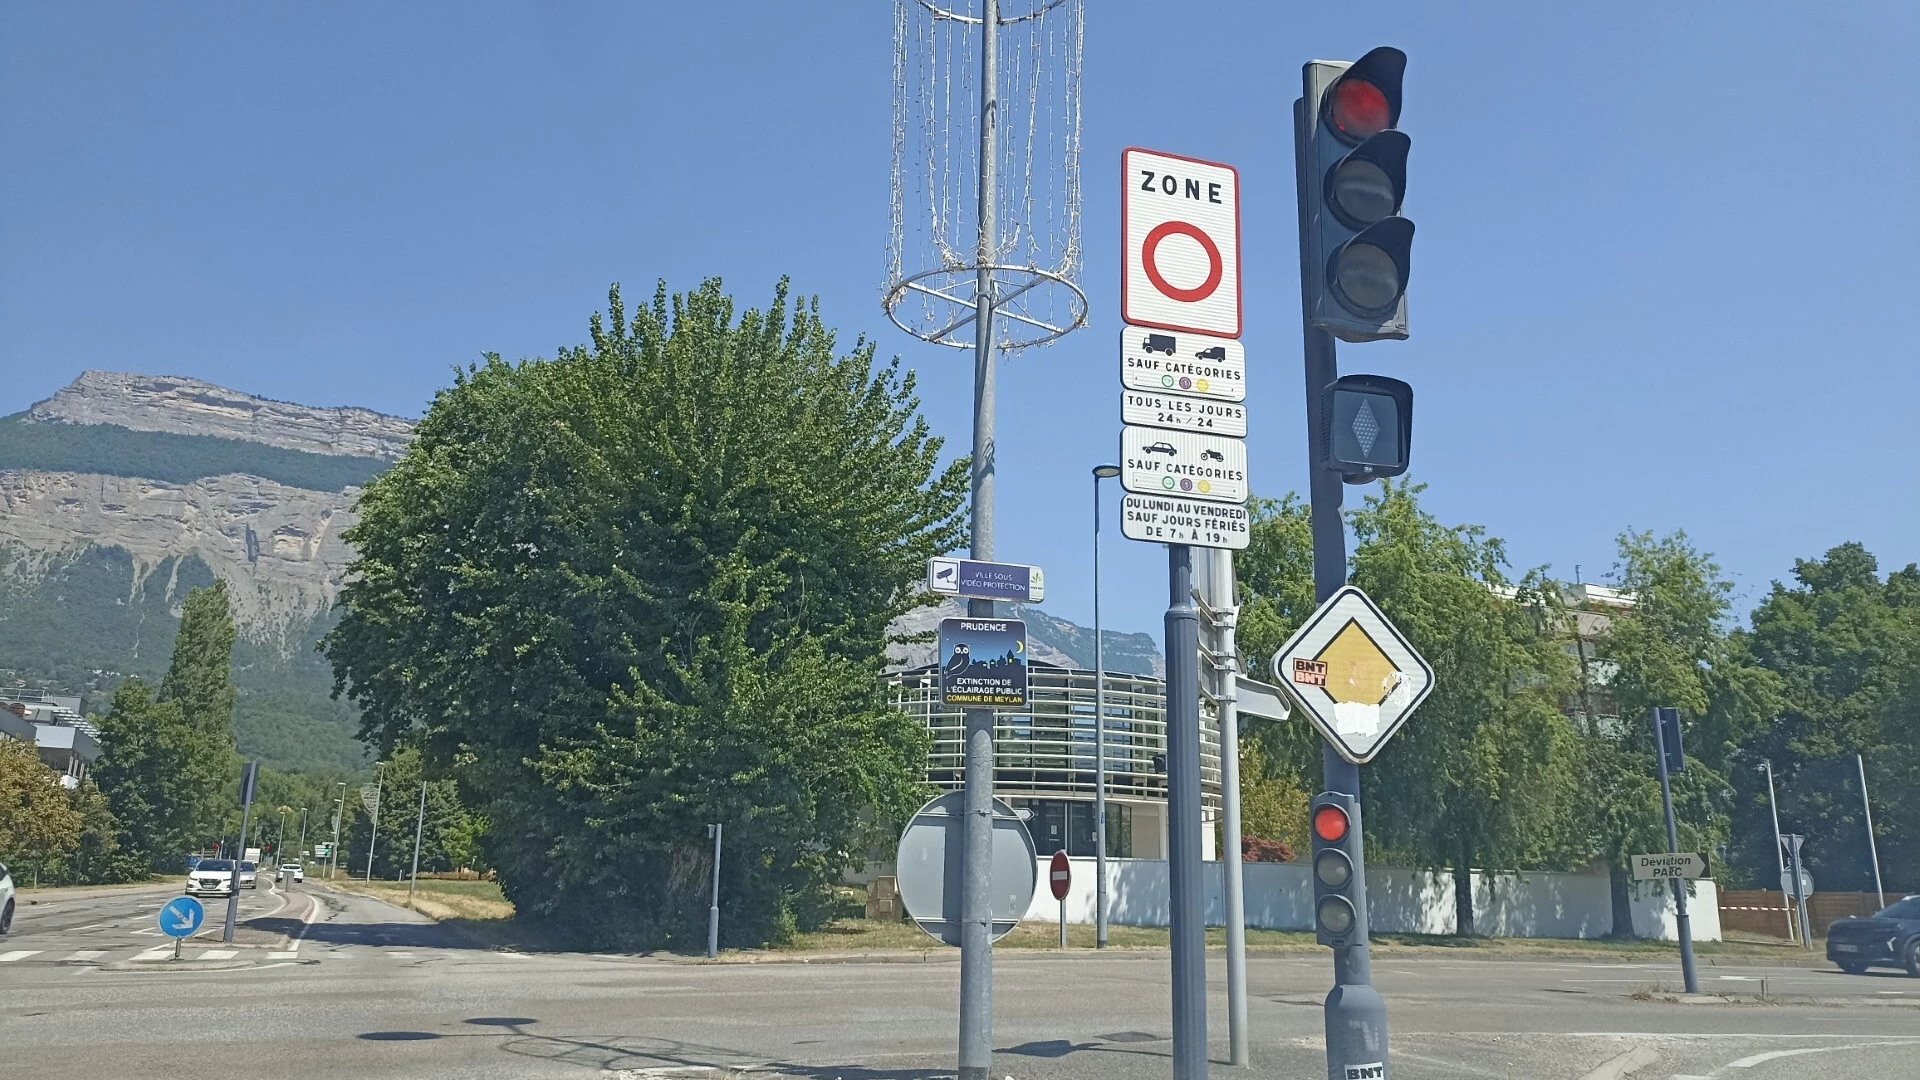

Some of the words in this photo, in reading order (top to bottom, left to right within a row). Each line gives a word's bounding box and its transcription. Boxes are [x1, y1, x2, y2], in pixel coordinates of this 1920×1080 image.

[1142, 170, 1222, 204] ZONE
[1128, 358, 1159, 370] SAUF
[1165, 363, 1241, 380] CATÉGORIES
[1128, 396, 1162, 408] TOUS
[1168, 400, 1191, 412] LES
[1199, 405, 1242, 418] JOURS
[1128, 459, 1160, 471] SAUF
[1166, 463, 1243, 480] CATÉGORIES
[1127, 498, 1140, 508] DU
[1143, 500, 1174, 511] LUNDI
[1177, 504, 1190, 514] AU
[1193, 505, 1246, 519] VENDREDI
[1127, 511, 1158, 523] SAUF
[1162, 515, 1201, 528] JOURS
[1205, 518, 1246, 532] FÉRIÉS
[1146, 526, 1162, 537] DE
[1191, 528, 1198, 540] À
[975, 571, 992, 579] VILLE
[994, 573, 1012, 581] SOUS
[983, 581, 1025, 591] PROTECTION
[960, 622, 1007, 632] PRUDENCE
[1296, 661, 1324, 673] BNT
[1295, 671, 1325, 685] BNT
[946, 685, 994, 694] L'ÉCLAIRAGE
[1347, 1066, 1382, 1079] BNT
